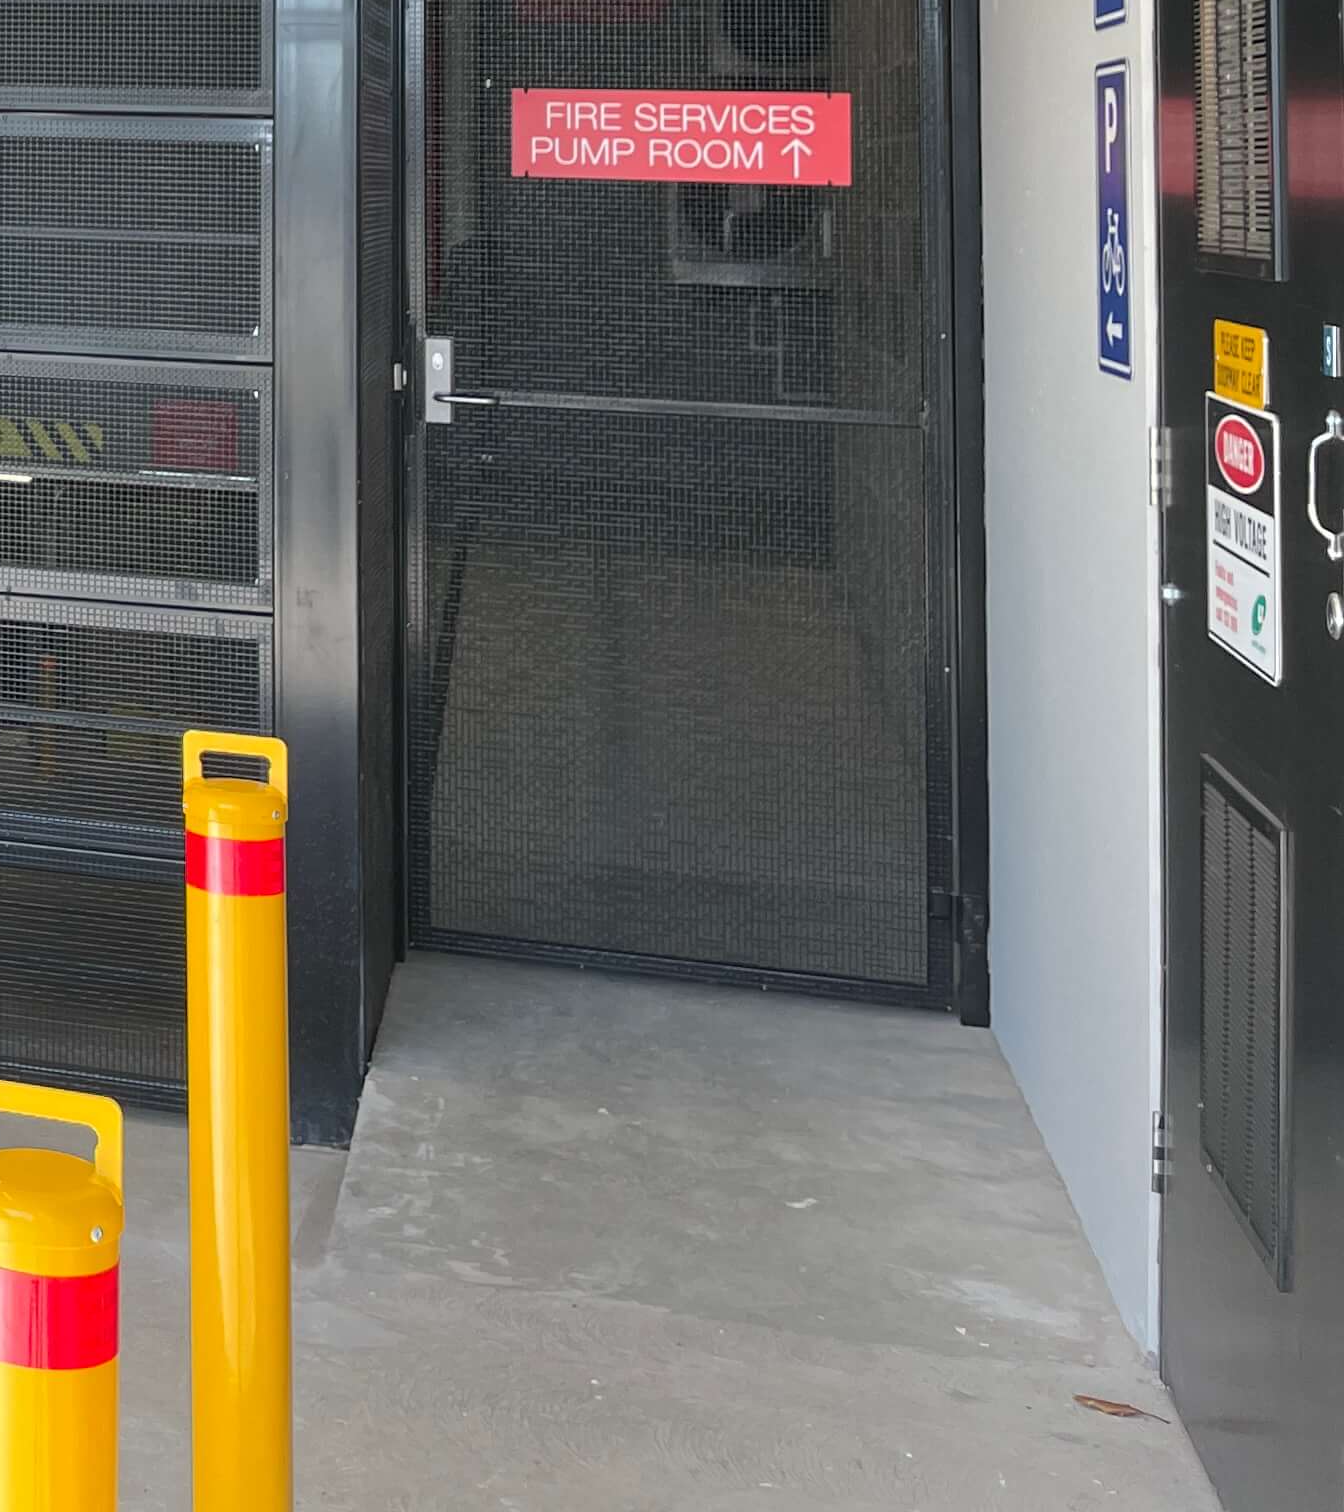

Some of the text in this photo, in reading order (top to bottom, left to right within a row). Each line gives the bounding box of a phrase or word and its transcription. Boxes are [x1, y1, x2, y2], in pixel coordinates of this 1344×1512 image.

[545, 101, 816, 136] FIRE SERVICES
[1104, 87, 1118, 173] P
[530, 136, 764, 170] PUMP ROOM
[1222, 430, 1255, 477] DANGER
[1214, 498, 1268, 562] HIGH VOLTAGE
